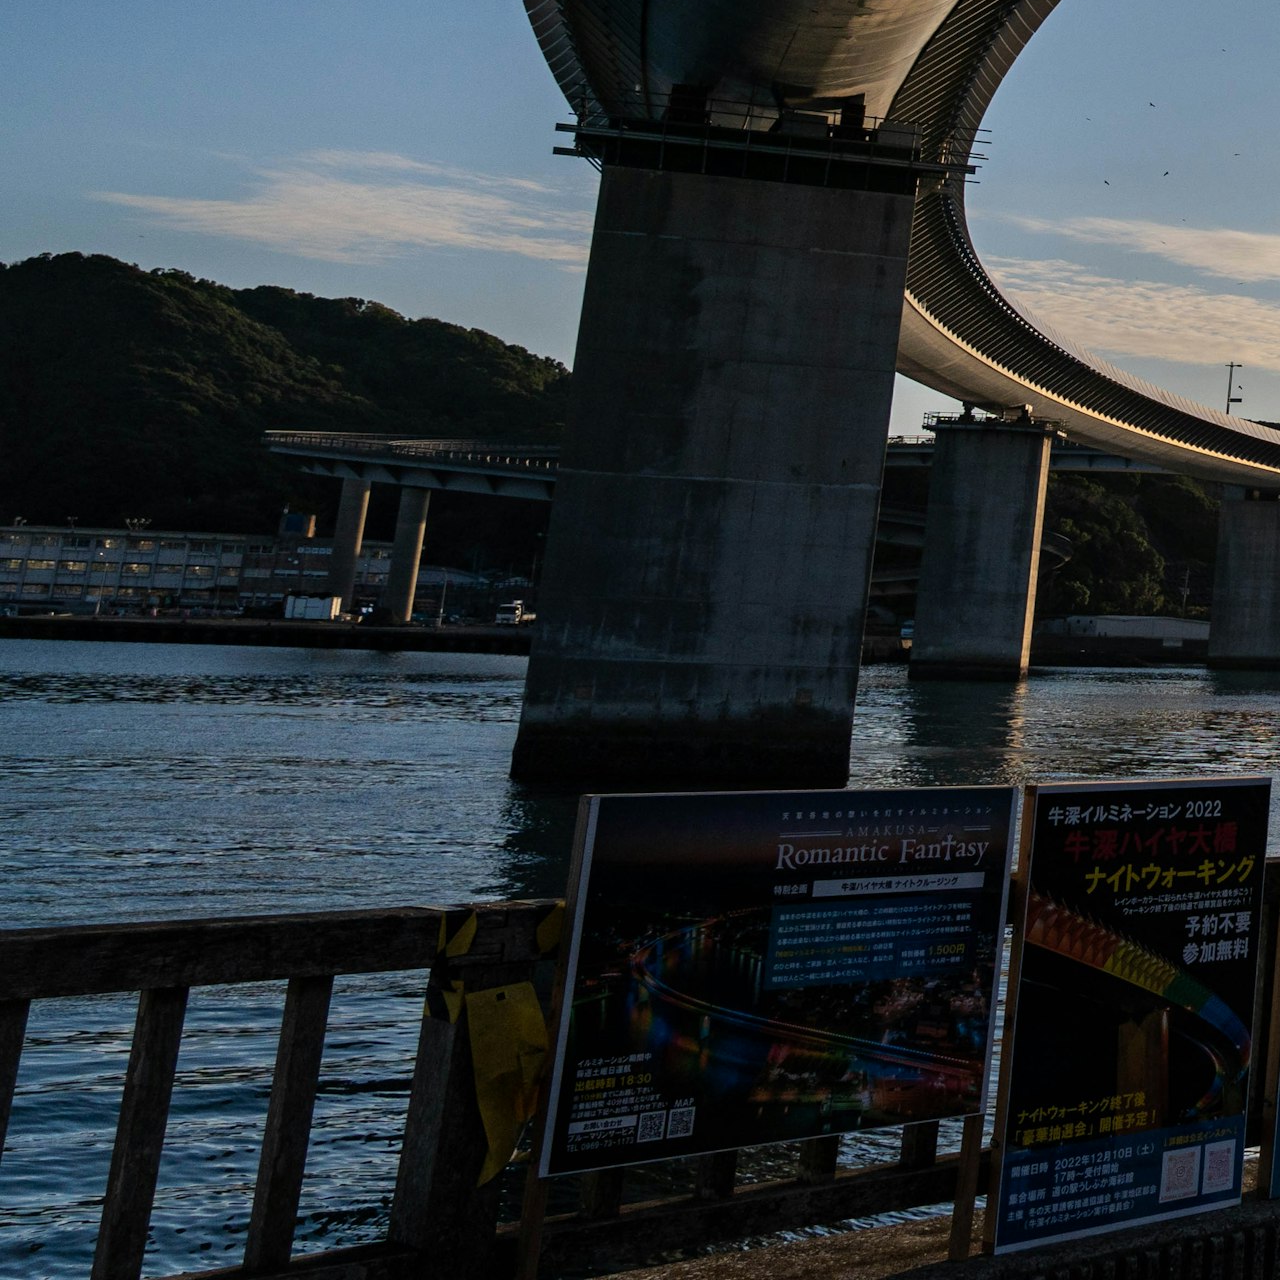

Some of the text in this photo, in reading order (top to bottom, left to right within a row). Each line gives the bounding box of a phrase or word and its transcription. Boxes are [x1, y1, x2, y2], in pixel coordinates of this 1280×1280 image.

[1048, 799, 1222, 826] 牛深イルミネーション 2022
[846, 825, 926, 838] AMAKUSA
[1063, 820, 1239, 864] 牛深ハイヤ大橋
[775, 833, 991, 871] Romantic Fantasy
[894, 876, 959, 889] ナイトクルージング
[1085, 854, 1256, 894] ナイトウォーキング
[1184, 910, 1253, 938] 予約不要
[1182, 937, 1249, 965] 参加無料
[619, 1072, 653, 1086] 18:30
[673, 1096, 696, 1109] MAP
[1017, 1091, 1146, 1125] ナイトウォーキング終了後
[566, 1144, 579, 1153] TEL
[1010, 1162, 1049, 1178] 開催日時
[1008, 1187, 1046, 1205] 集合場所
